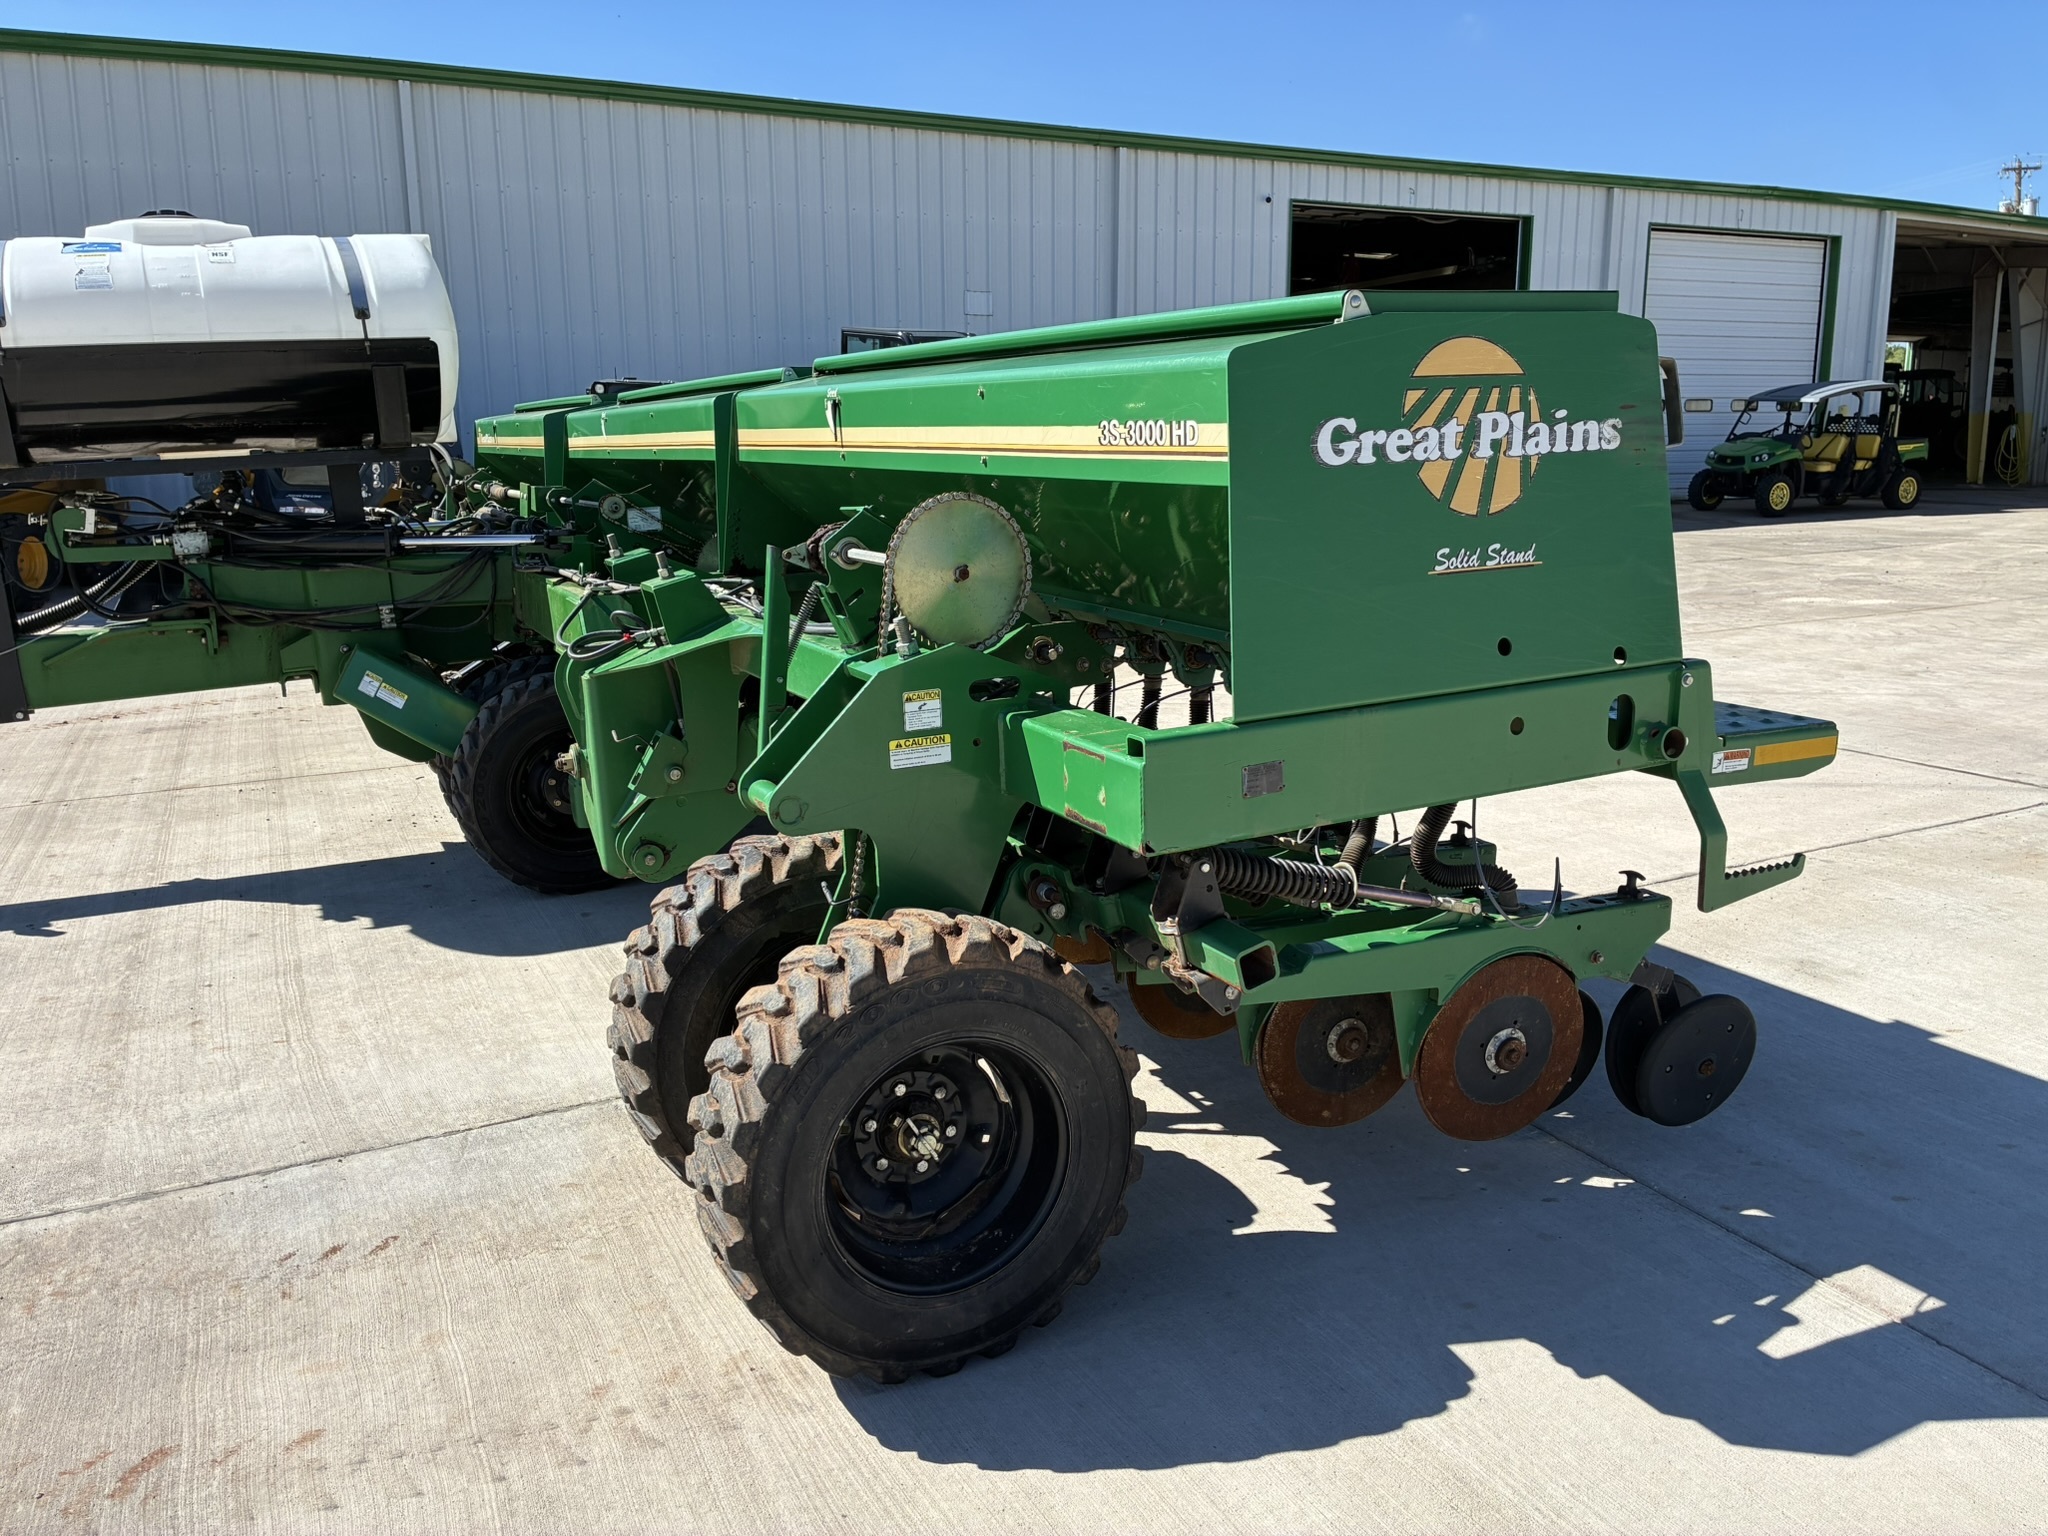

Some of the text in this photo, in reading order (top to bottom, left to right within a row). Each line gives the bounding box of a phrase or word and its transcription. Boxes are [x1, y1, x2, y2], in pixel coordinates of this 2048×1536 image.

[1098, 419, 1199, 446] 3S-3000 HD
[1312, 409, 1623, 467] Great Plains
[1434, 543, 1536, 571] Solid Stand
[911, 691, 940, 701] CAUTION
[903, 735, 946, 748] CAUTION
